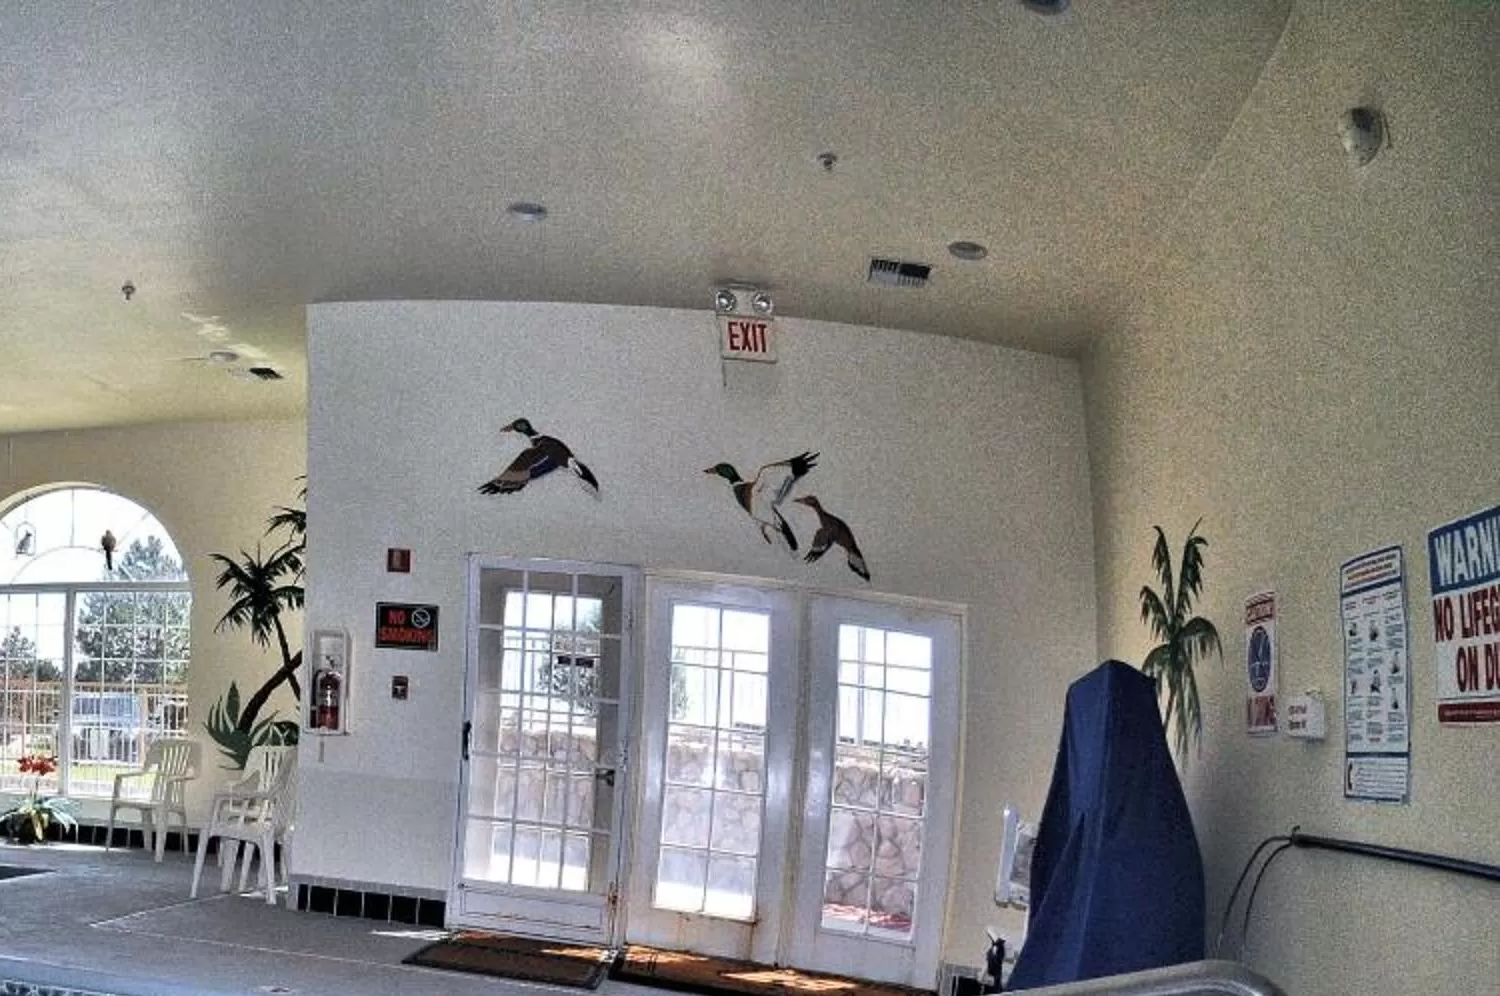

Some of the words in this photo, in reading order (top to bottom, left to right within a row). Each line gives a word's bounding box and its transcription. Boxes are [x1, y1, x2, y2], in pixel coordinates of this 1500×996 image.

[727, 321, 767, 353] EXIT
[387, 609, 406, 625] NO
[1432, 597, 1454, 642] NO
[1456, 645, 1479, 692] ON
